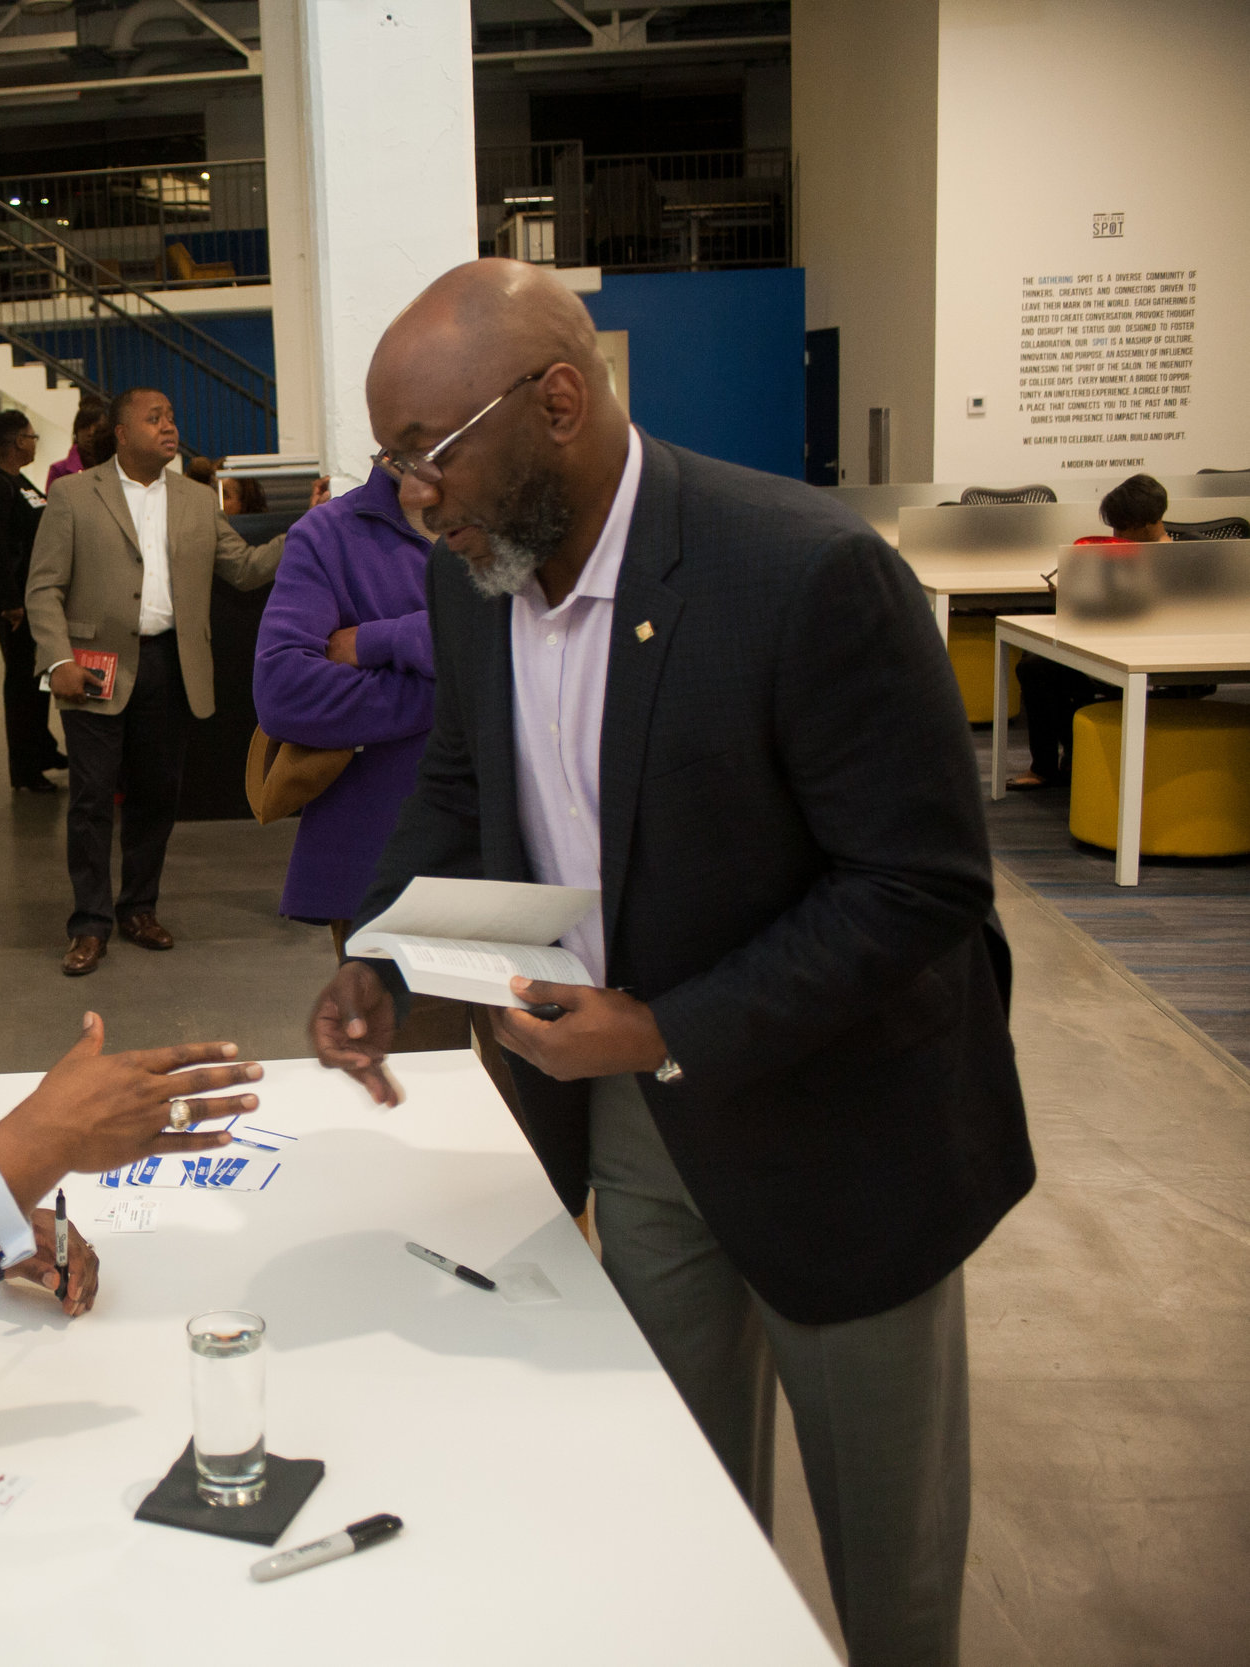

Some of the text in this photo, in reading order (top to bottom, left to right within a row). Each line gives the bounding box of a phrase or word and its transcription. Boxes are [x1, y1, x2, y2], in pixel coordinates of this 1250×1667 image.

[1093, 222, 1123, 236] SPOT
[1023, 277, 1033, 285] THE
[1038, 276, 1073, 284] GATHERING
[1078, 275, 1092, 283] SPOT
[1097, 274, 1103, 282] IS
[1116, 273, 1141, 281] DIVERSE
[1146, 272, 1184, 280] COMMUNITY
[1059, 288, 1092, 296] CREATIVES
[1098, 287, 1110, 295] AND
[1115, 285, 1155, 294] CONNECTORS
[1160, 284, 1183, 292] DRIVEN
[1022, 303, 1040, 311] LEAVE
[1044, 302, 1061, 310] THEIR
[1063, 301, 1081, 309] MARK
[1094, 300, 1104, 308] THE
[1134, 298, 1150, 306] EACH
[1153, 297, 1187, 305] GATHERING
[1189, 296, 1195, 304] IS
[1022, 315, 1049, 323] CURATED
[1051, 314, 1058, 322] TO
[1061, 313, 1083, 322] CREATE
[1136, 311, 1163, 319] PROVOKE
[1021, 328, 1034, 336] AND
[1038, 327, 1063, 335] DISRUPT
[1082, 326, 1105, 334] STATUS
[1126, 323, 1156, 332] DESIGNED
[1161, 323, 1167, 331] TO
[1171, 322, 1194, 330] FOSTER
[1092, 338, 1108, 346] SPOT
[1126, 336, 1152, 344] MASHUP
[1154, 336, 1162, 344] OF
[1106, 350, 1114, 358] AN
[1116, 349, 1148, 357] ASSEMBLY
[1159, 347, 1193, 355] INFLUENCE
[1020, 365, 1059, 373] HARNESSING
[1062, 364, 1072, 372] THE
[1076, 364, 1095, 372] SPIRIT
[1097, 363, 1105, 371] OF
[1146, 361, 1157, 369] THE
[1160, 360, 1192, 368] INGENUITY
[1029, 378, 1055, 386] COLLEGE
[1078, 376, 1097, 384] EVERY
[1136, 374, 1157, 382] BRIDGE
[1169, 373, 1191, 381] OPPOR-
[1044, 390, 1052, 398] AN
[1054, 389, 1090, 398] UNFILTERED
[1139, 387, 1160, 395] CIRCLE
[1162, 386, 1170, 394] OF
[1027, 403, 1045, 411] PLACE
[1050, 402, 1064, 410] THAT
[1068, 401, 1100, 410] CONNECTS
[1145, 399, 1160, 407] PAST
[1180, 398, 1191, 406] RE-
[1031, 416, 1053, 424] QUIRES
[1072, 414, 1103, 422] PRESENCE
[1106, 413, 1113, 421] TO
[1140, 412, 1150, 420] THE
[1153, 411, 1178, 419] FUTURE.
[1023, 437, 1031, 445] WE
[1034, 436, 1057, 444] GATHER
[1130, 433, 1148, 441] BUILD
[1068, 460, 1107, 468] MODERN-DAY
